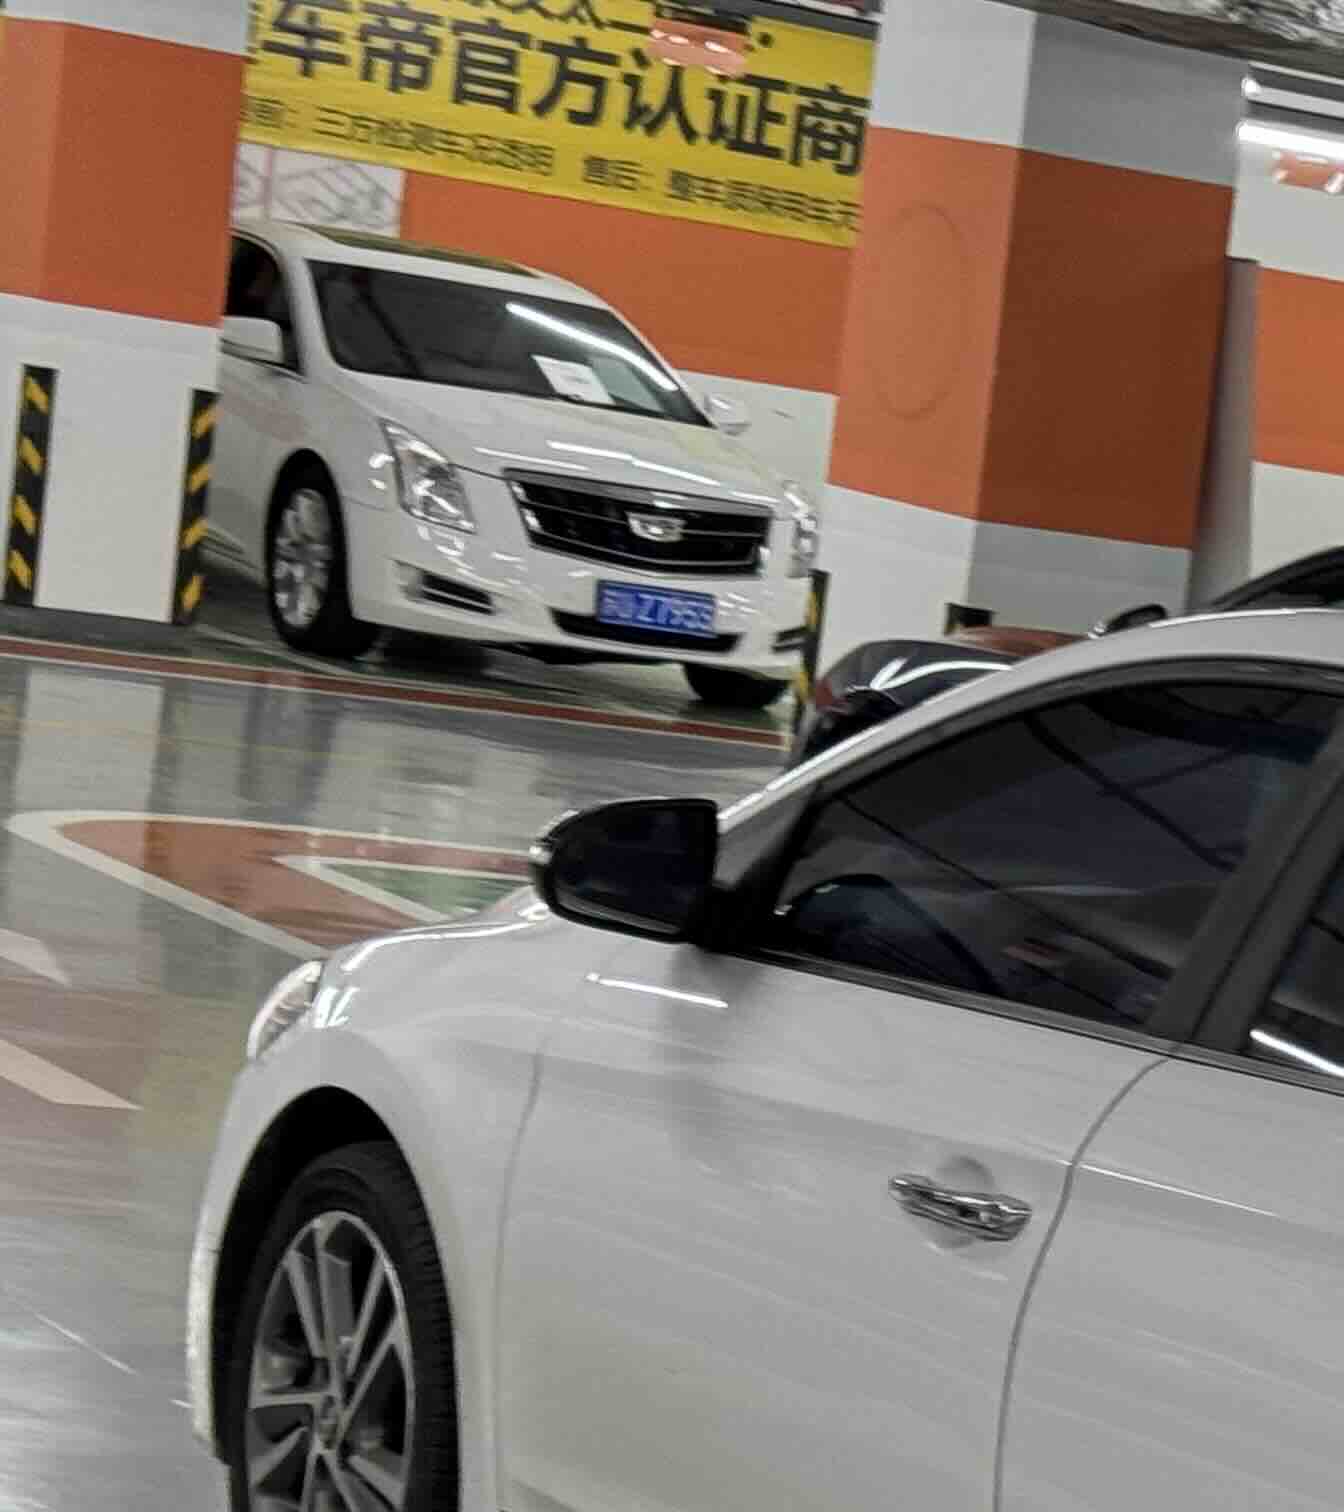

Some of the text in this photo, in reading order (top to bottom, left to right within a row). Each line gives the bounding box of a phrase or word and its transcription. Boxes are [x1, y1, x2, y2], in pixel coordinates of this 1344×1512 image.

[247, 0, 866, 177] 车帝官方认证商
